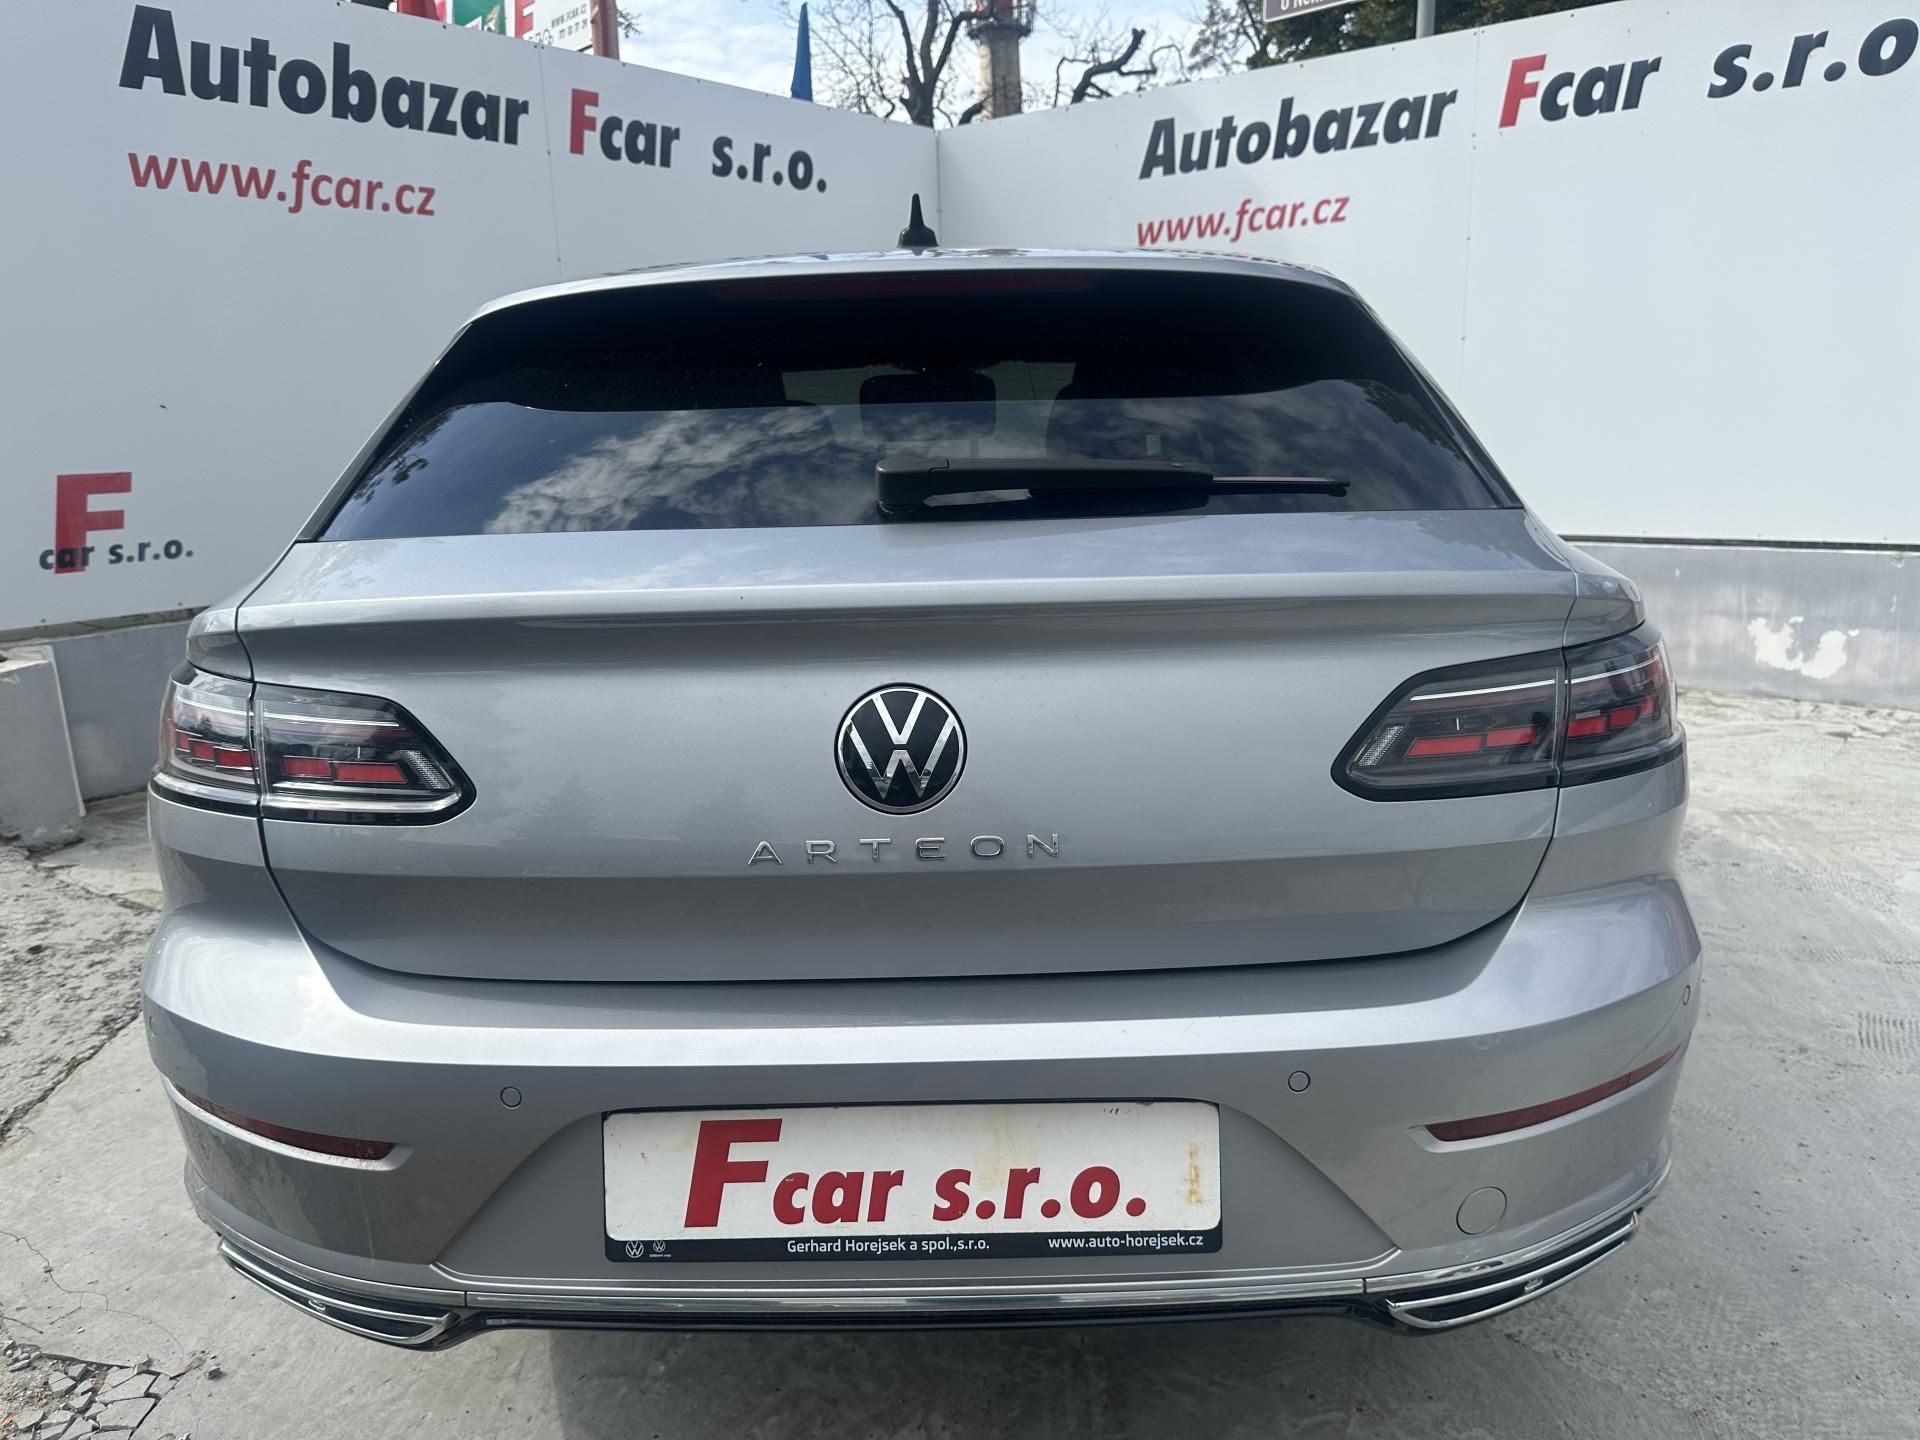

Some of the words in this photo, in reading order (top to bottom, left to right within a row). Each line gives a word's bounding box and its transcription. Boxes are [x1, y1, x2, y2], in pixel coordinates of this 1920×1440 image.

[119, 4, 529, 145] Autobazar
[570, 89, 680, 168] Fcar
[712, 136, 828, 193] s.r.o.
[1137, 88, 1457, 180] Autobazar
[1499, 54, 1662, 128] Fcar
[128, 153, 435, 216] www.fcar.cz
[1137, 196, 1349, 246] www.fcar.cz
[108, 539, 194, 564] s.r.o.
[748, 833, 1059, 865] ARTEON
[684, 1117, 904, 1228] Fcar
[932, 1165, 1148, 1222] s.r.o.
[787, 1239, 841, 1252] Gerhard
[845, 1237, 905, 1254] Horejsek
[909, 1240, 917, 1250] a
[1048, 1233, 1203, 1249] www.auto-horejsek.cz
